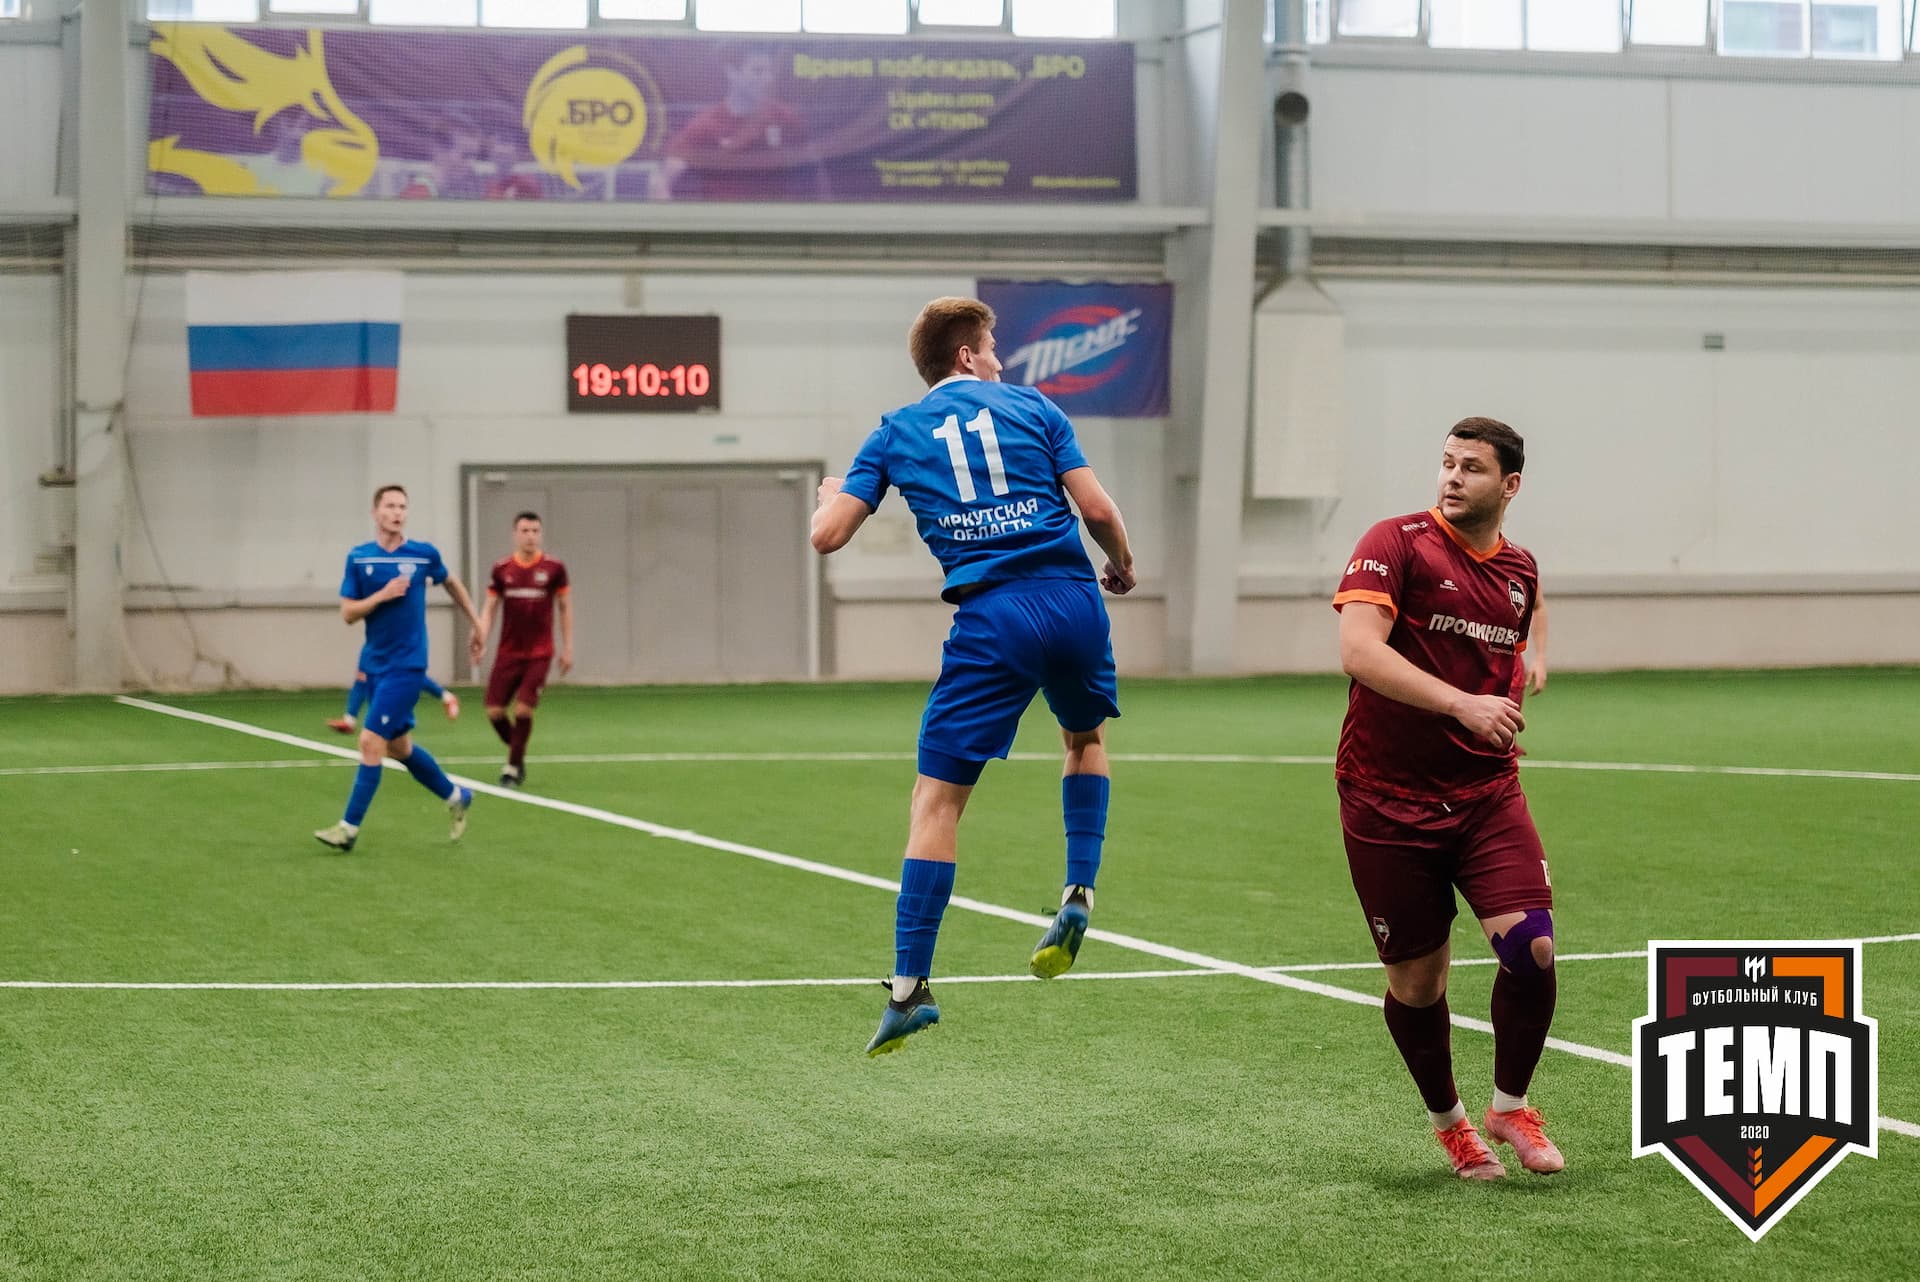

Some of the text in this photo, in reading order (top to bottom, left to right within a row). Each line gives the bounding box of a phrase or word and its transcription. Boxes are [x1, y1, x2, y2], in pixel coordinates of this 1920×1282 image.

[559, 98, 634, 126] .БРО
[572, 363, 710, 397] 19:10:10
[932, 407, 1010, 503] 11
[938, 497, 1039, 528] ИРКУТСКАЯ
[953, 518, 1033, 541] ОБЛАСТЬ
